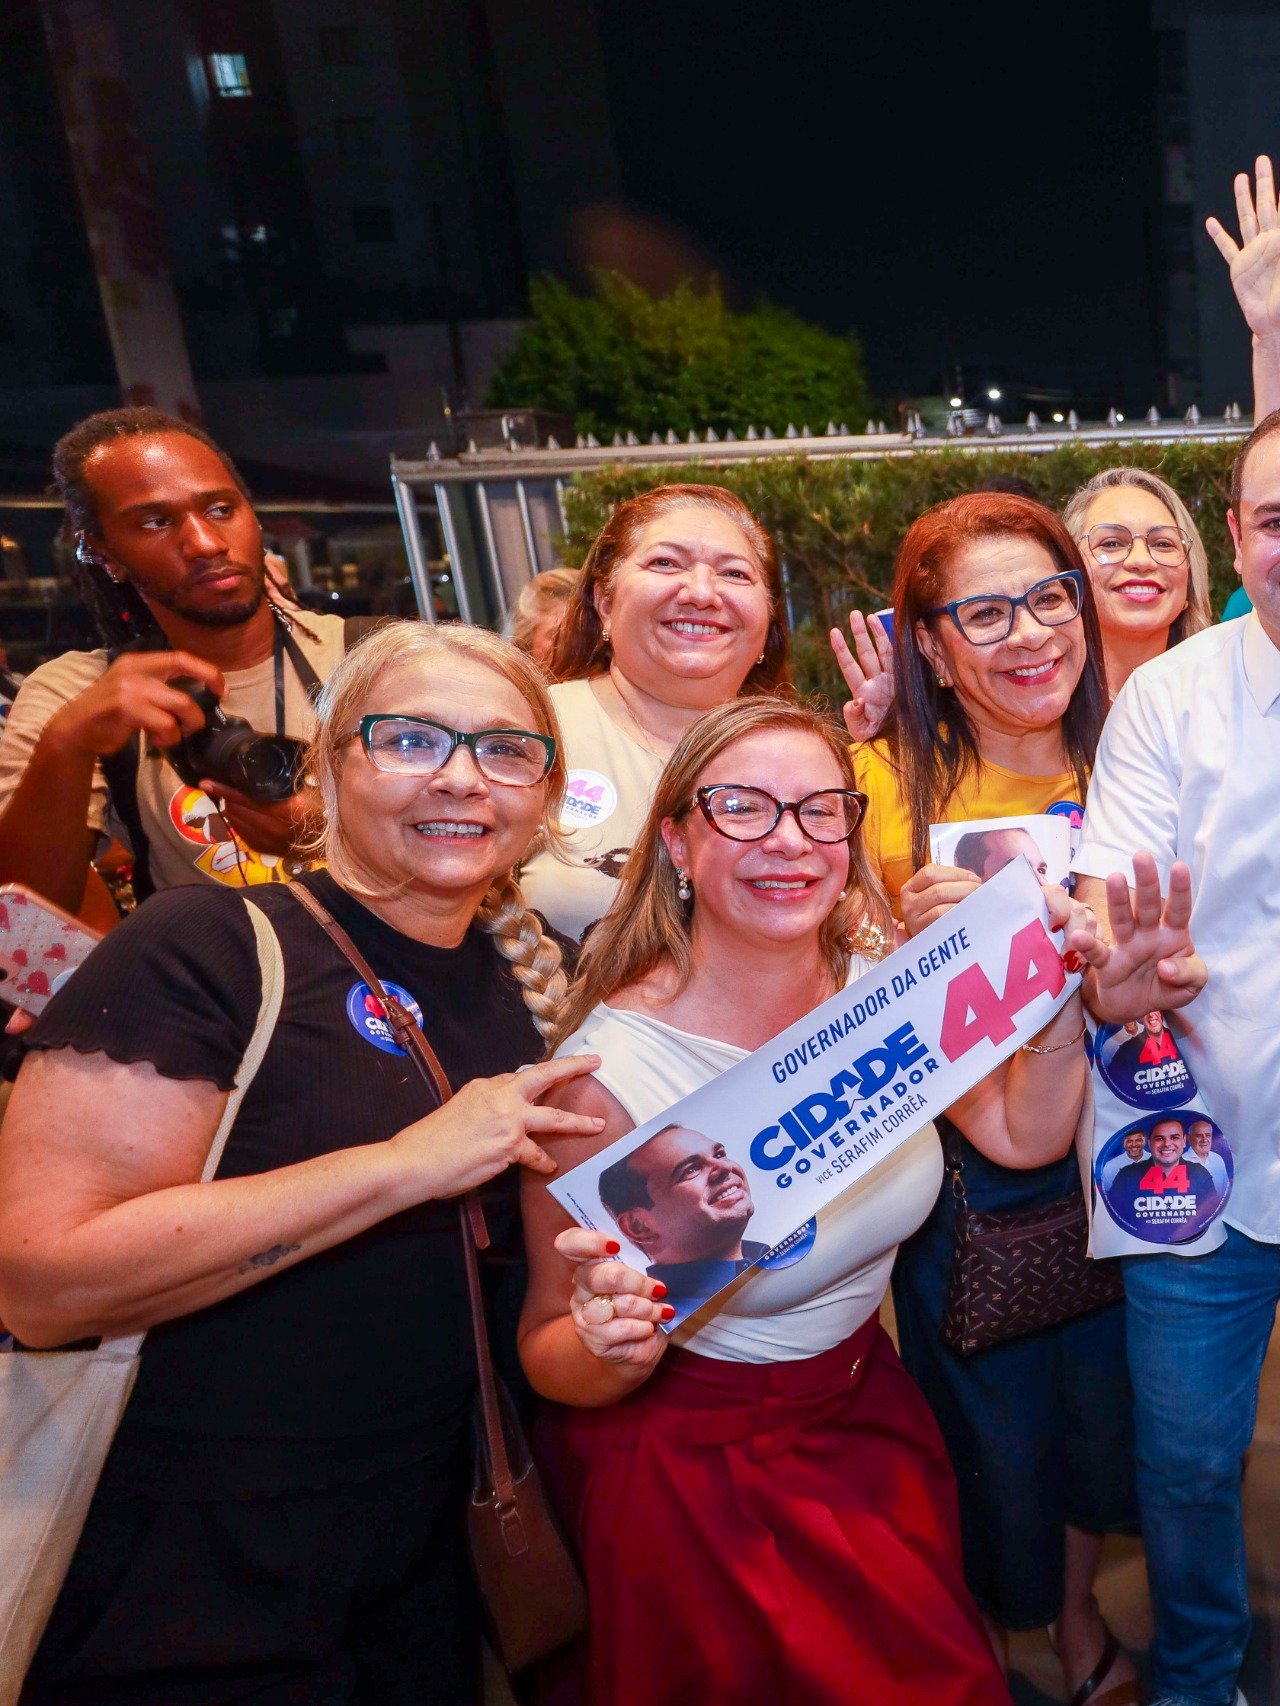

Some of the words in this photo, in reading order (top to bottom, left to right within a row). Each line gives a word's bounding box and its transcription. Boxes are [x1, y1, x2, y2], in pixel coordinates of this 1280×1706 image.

[566, 795, 601, 815] DADE
[568, 779, 605, 803] 44
[772, 986, 891, 1084] GOVERNADOR
[891, 968, 918, 998] DA
[918, 927, 971, 978] GENTE
[939, 917, 1066, 1063] 44
[1138, 1031, 1178, 1066] 44
[1134, 1060, 1187, 1084] CIDADE
[1135, 1074, 1189, 1091] GOVERNADOR
[749, 1021, 929, 1171] CIDADE
[776, 1057, 940, 1189] GOVERNADOR
[815, 1169, 834, 1185] VICE
[831, 1127, 884, 1178] SERAFIM
[883, 1092, 928, 1133] CORRÊA
[1139, 1164, 1191, 1195] 44
[1134, 1194, 1197, 1211] CIDADE
[1135, 1210, 1197, 1218] GOVERNADOR
[764, 1223, 810, 1260] GOVERNADOR
